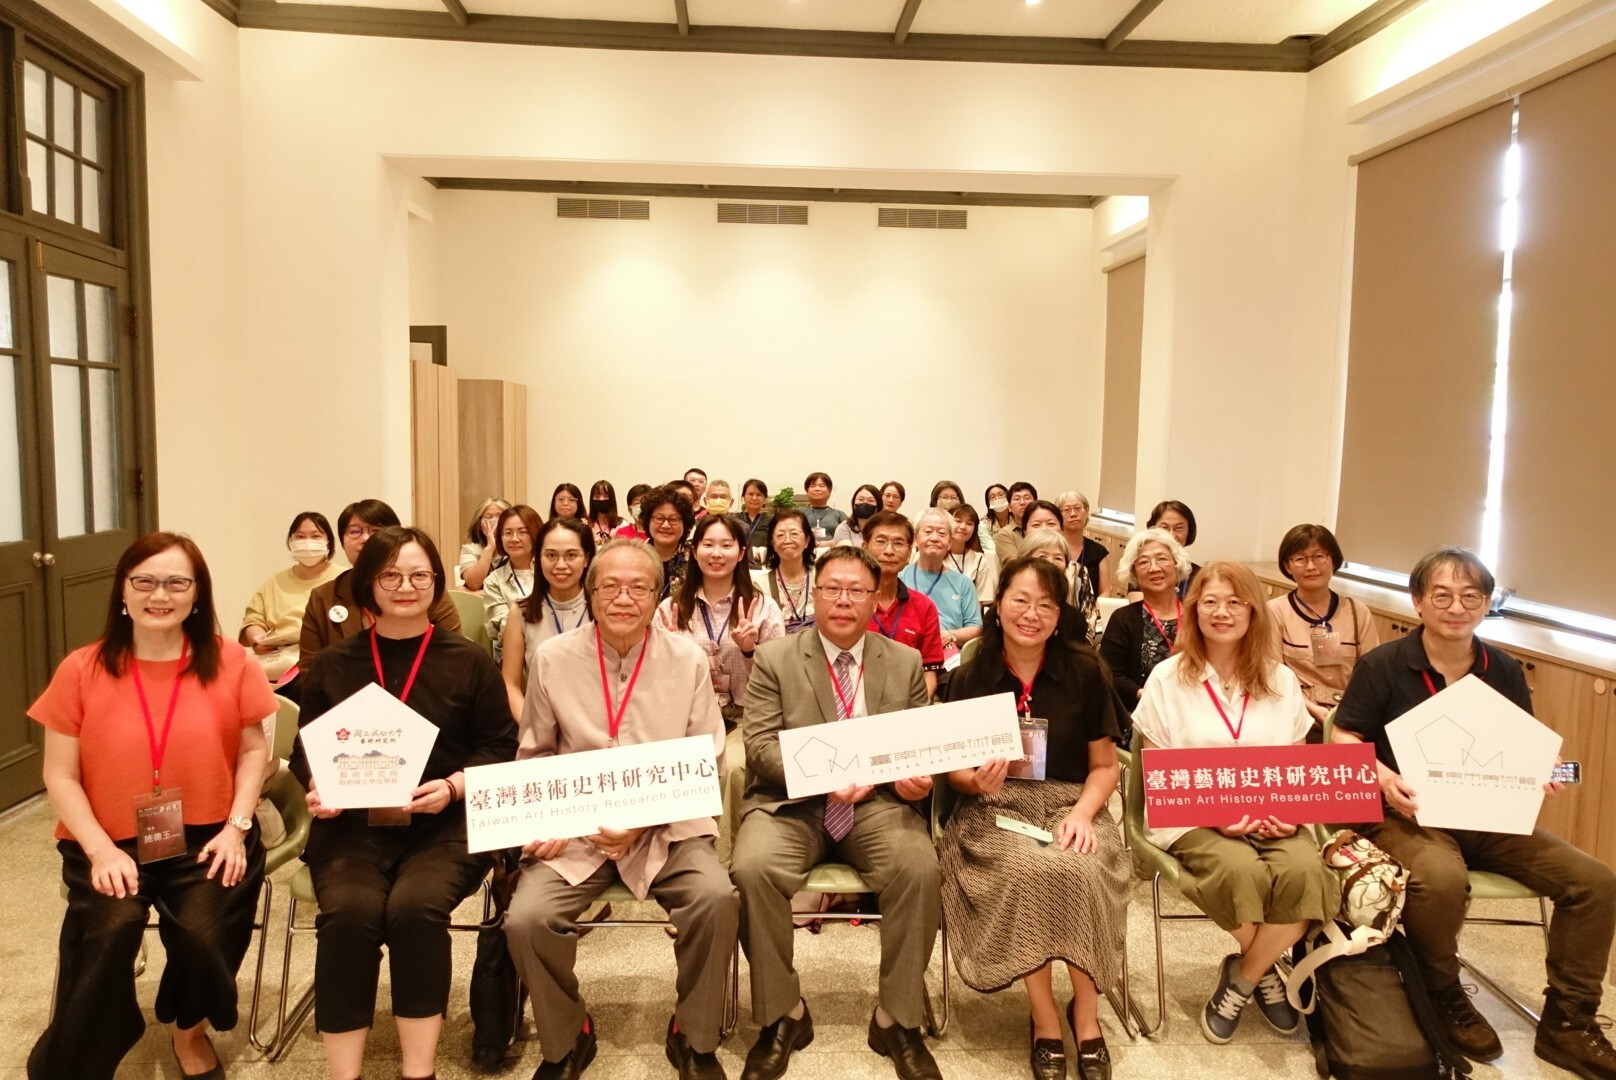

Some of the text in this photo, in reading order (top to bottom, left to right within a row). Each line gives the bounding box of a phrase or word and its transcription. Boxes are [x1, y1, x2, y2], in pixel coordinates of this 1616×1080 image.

[470, 757, 716, 813] 臺灣藝術史料研究中心
[1146, 764, 1378, 791] 臺灣藝術史料研究中心
[470, 785, 716, 829] Taiwan Art History Research Center
[1147, 790, 1378, 806] Taiwan Art History Research Center
